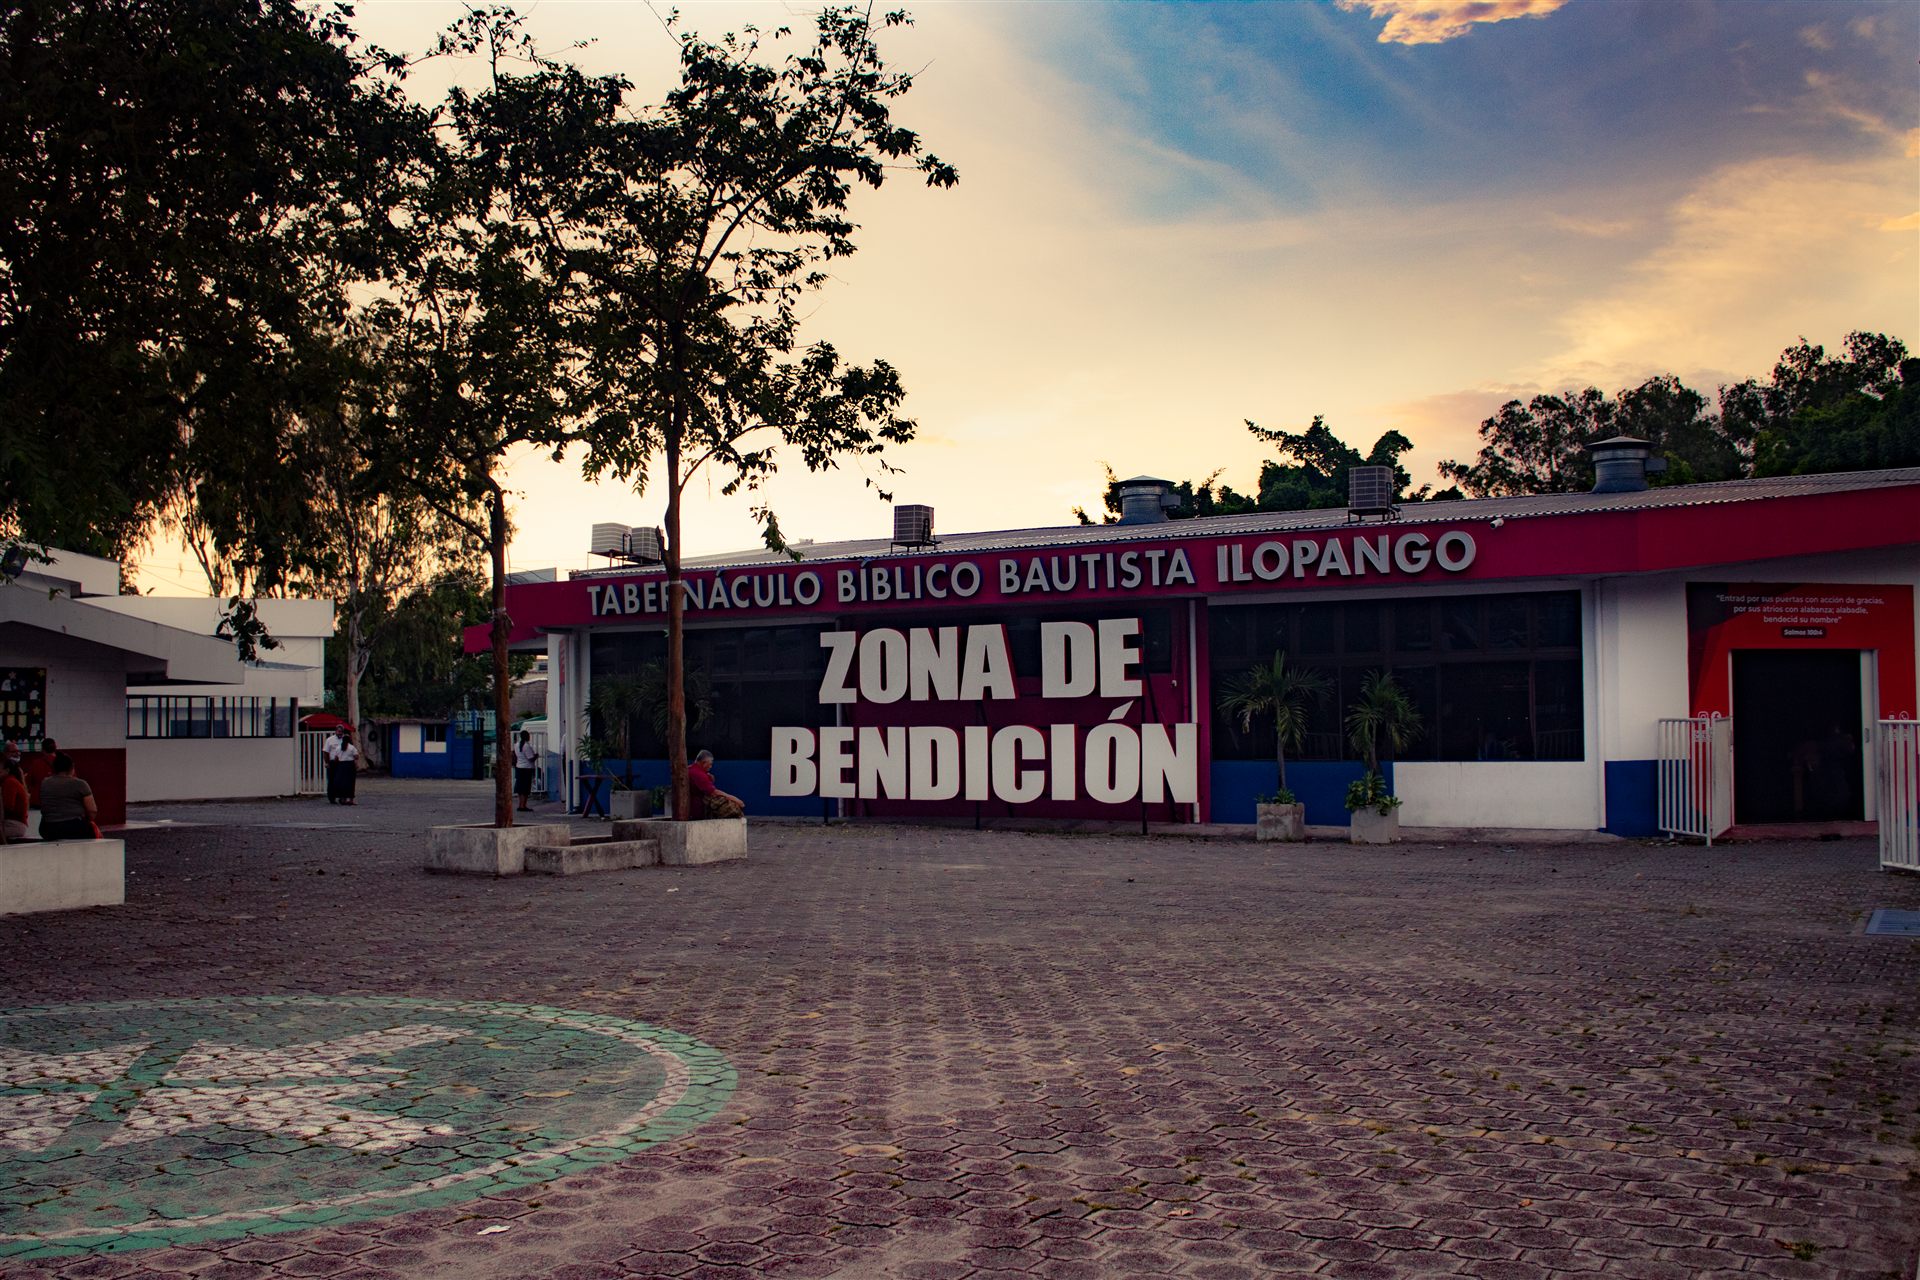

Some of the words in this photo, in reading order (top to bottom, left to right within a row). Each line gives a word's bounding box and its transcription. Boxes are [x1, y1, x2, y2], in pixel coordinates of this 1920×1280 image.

[837, 559, 983, 604] BÍBLICO
[1000, 548, 1195, 595] BAUTISTA
[1217, 531, 1477, 584] ILOPANGO
[1733, 606, 1747, 614] por
[1762, 605, 1784, 613] atrios
[1799, 605, 1835, 614] alabanza;
[1747, 596, 1760, 604] por
[1775, 596, 1804, 605] puertas
[1820, 595, 1844, 604] acción
[1845, 596, 1856, 604] de
[1856, 596, 1885, 605] gracias,
[1763, 615, 1798, 623] bendecid
[818, 624, 1018, 705] ZONA
[1041, 618, 1144, 700] DE
[769, 701, 1199, 805] BENDICIÓN
